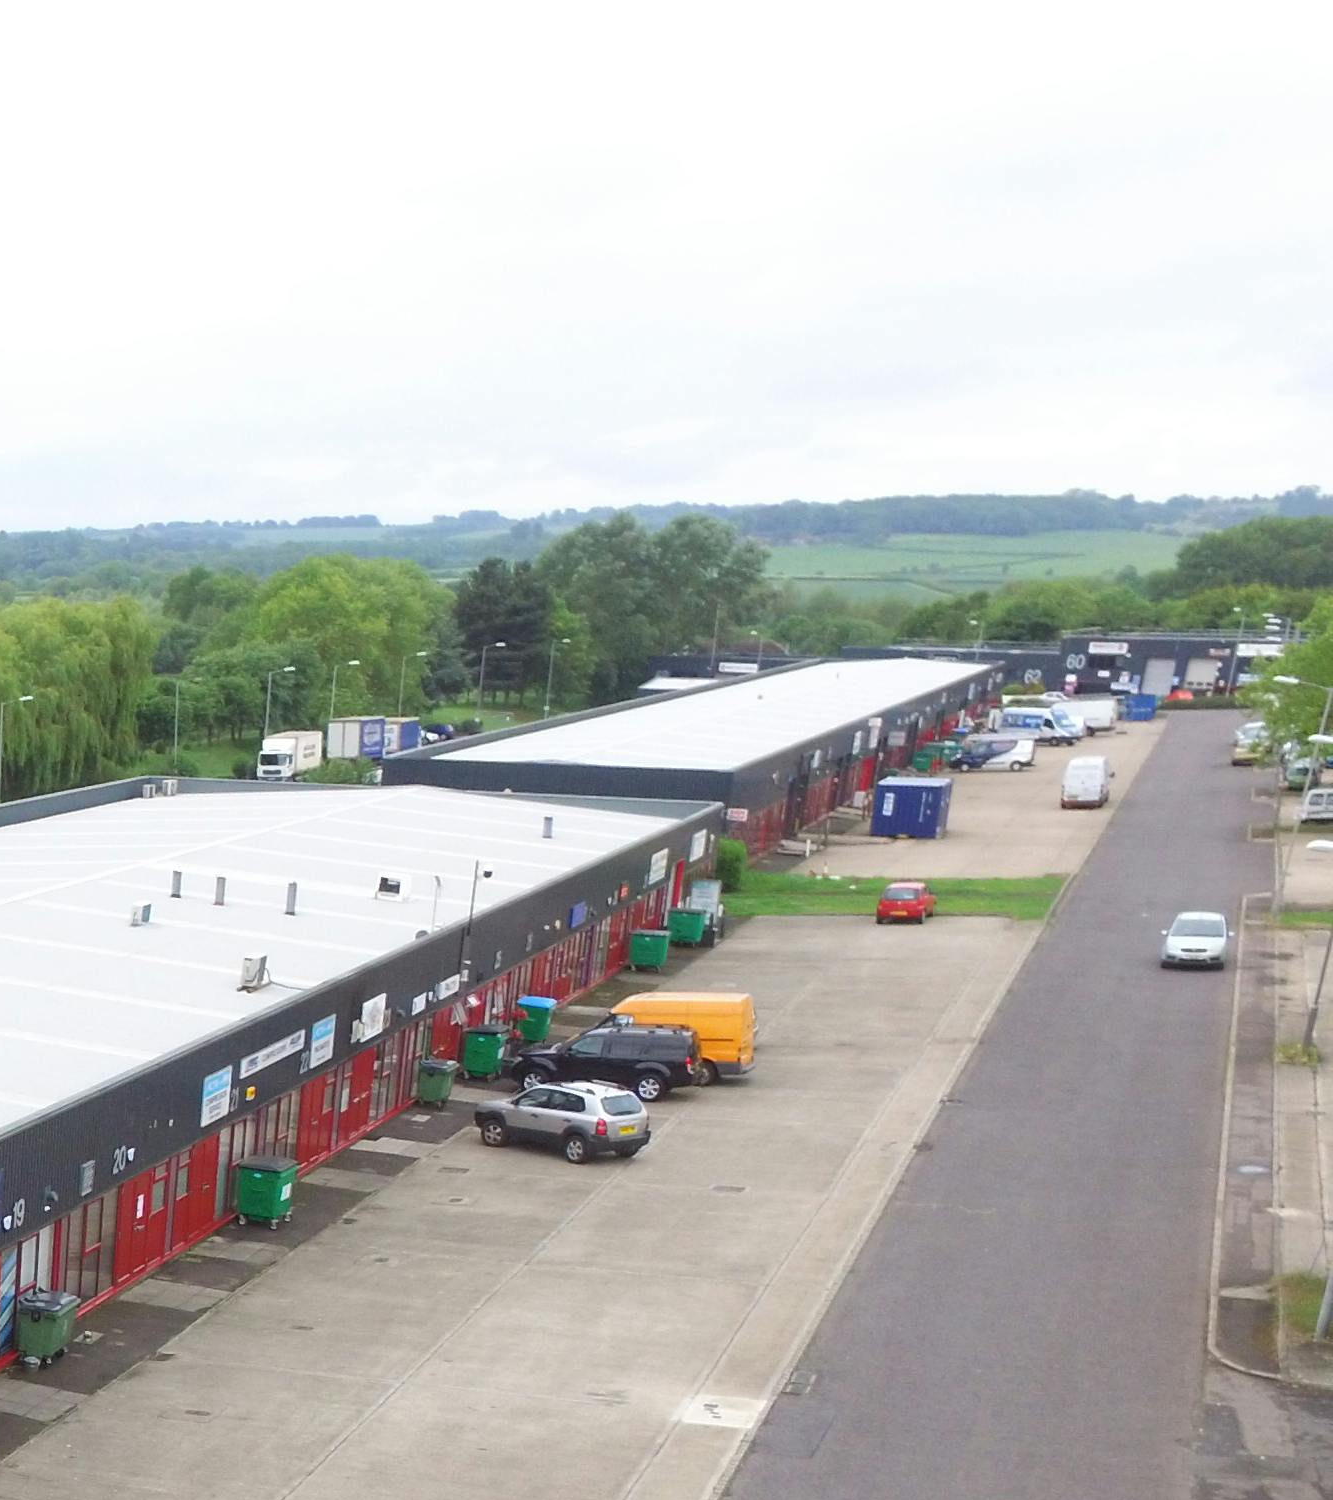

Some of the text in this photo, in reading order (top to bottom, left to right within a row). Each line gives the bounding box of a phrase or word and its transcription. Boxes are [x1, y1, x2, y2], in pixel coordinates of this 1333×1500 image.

[1066, 653, 1086, 669] 60
[1024, 668, 1042, 684] 62
[112, 1145, 126, 1175] 20
[13, 1198, 25, 1229] 19
